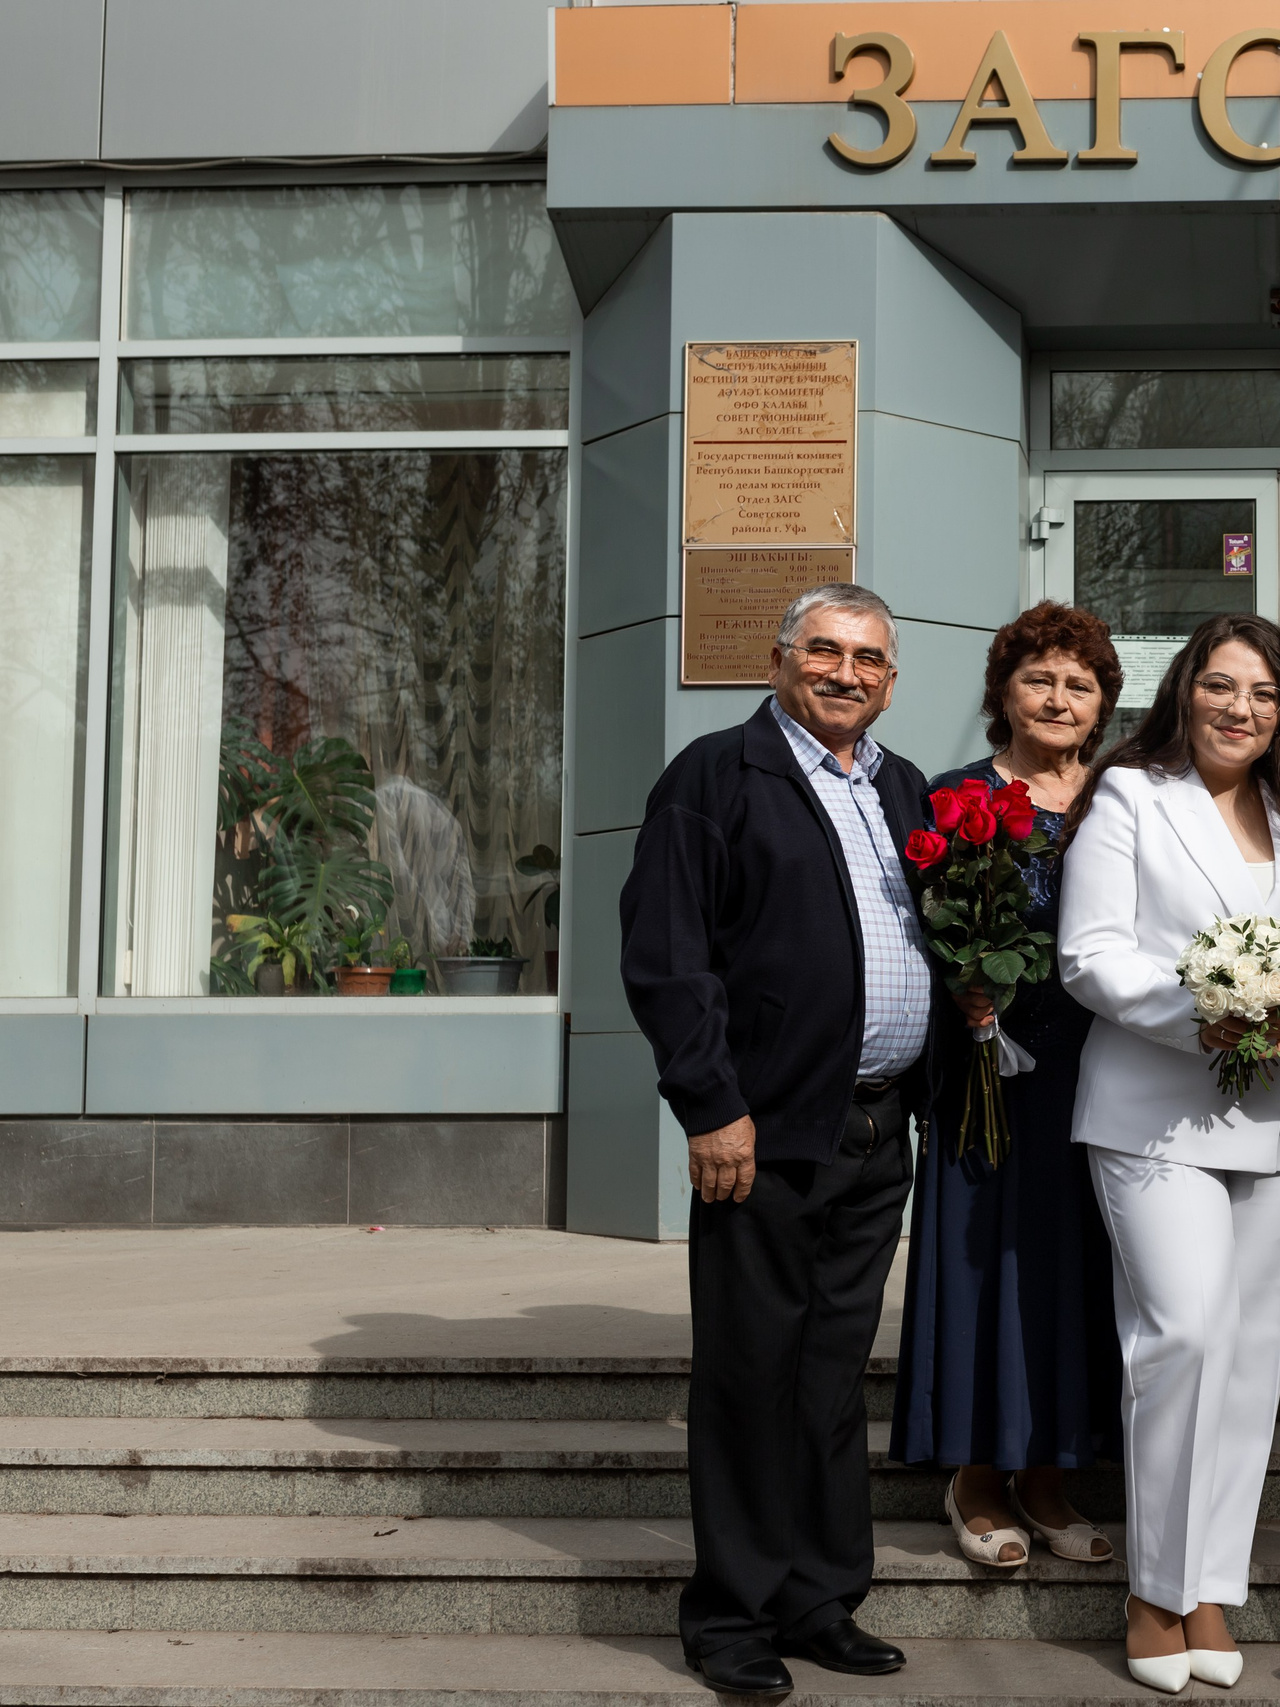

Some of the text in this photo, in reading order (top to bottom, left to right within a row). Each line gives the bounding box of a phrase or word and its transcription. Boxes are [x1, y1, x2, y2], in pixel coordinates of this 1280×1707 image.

[693, 375, 748, 384] ЮСТИЦИЯ
[763, 388, 824, 396] КОМИТЕТЫ
[733, 401, 759, 409] ӨФӨ
[716, 414, 750, 422] СОВЕТ
[737, 427, 763, 435] ЗАГС
[697, 451, 794, 462] Государственный
[696, 466, 844, 477] Республики Башкортостан
[735, 482, 768, 490] делам
[771, 482, 821, 490] юстиции
[737, 495, 802, 504] Отдел ЗАГС
[738, 510, 800, 518] Советского
[731, 525, 771, 535] района
[784, 524, 807, 535] Уфа
[726, 553, 747, 562] ЭШ
[816, 564, 839, 572] 18.00
[785, 575, 807, 583] 13.00
[816, 575, 839, 583] 14.00
[715, 620, 763, 629] РЕЖИМ
[699, 633, 737, 641] Вторник
[743, 633, 776, 641] суббота
